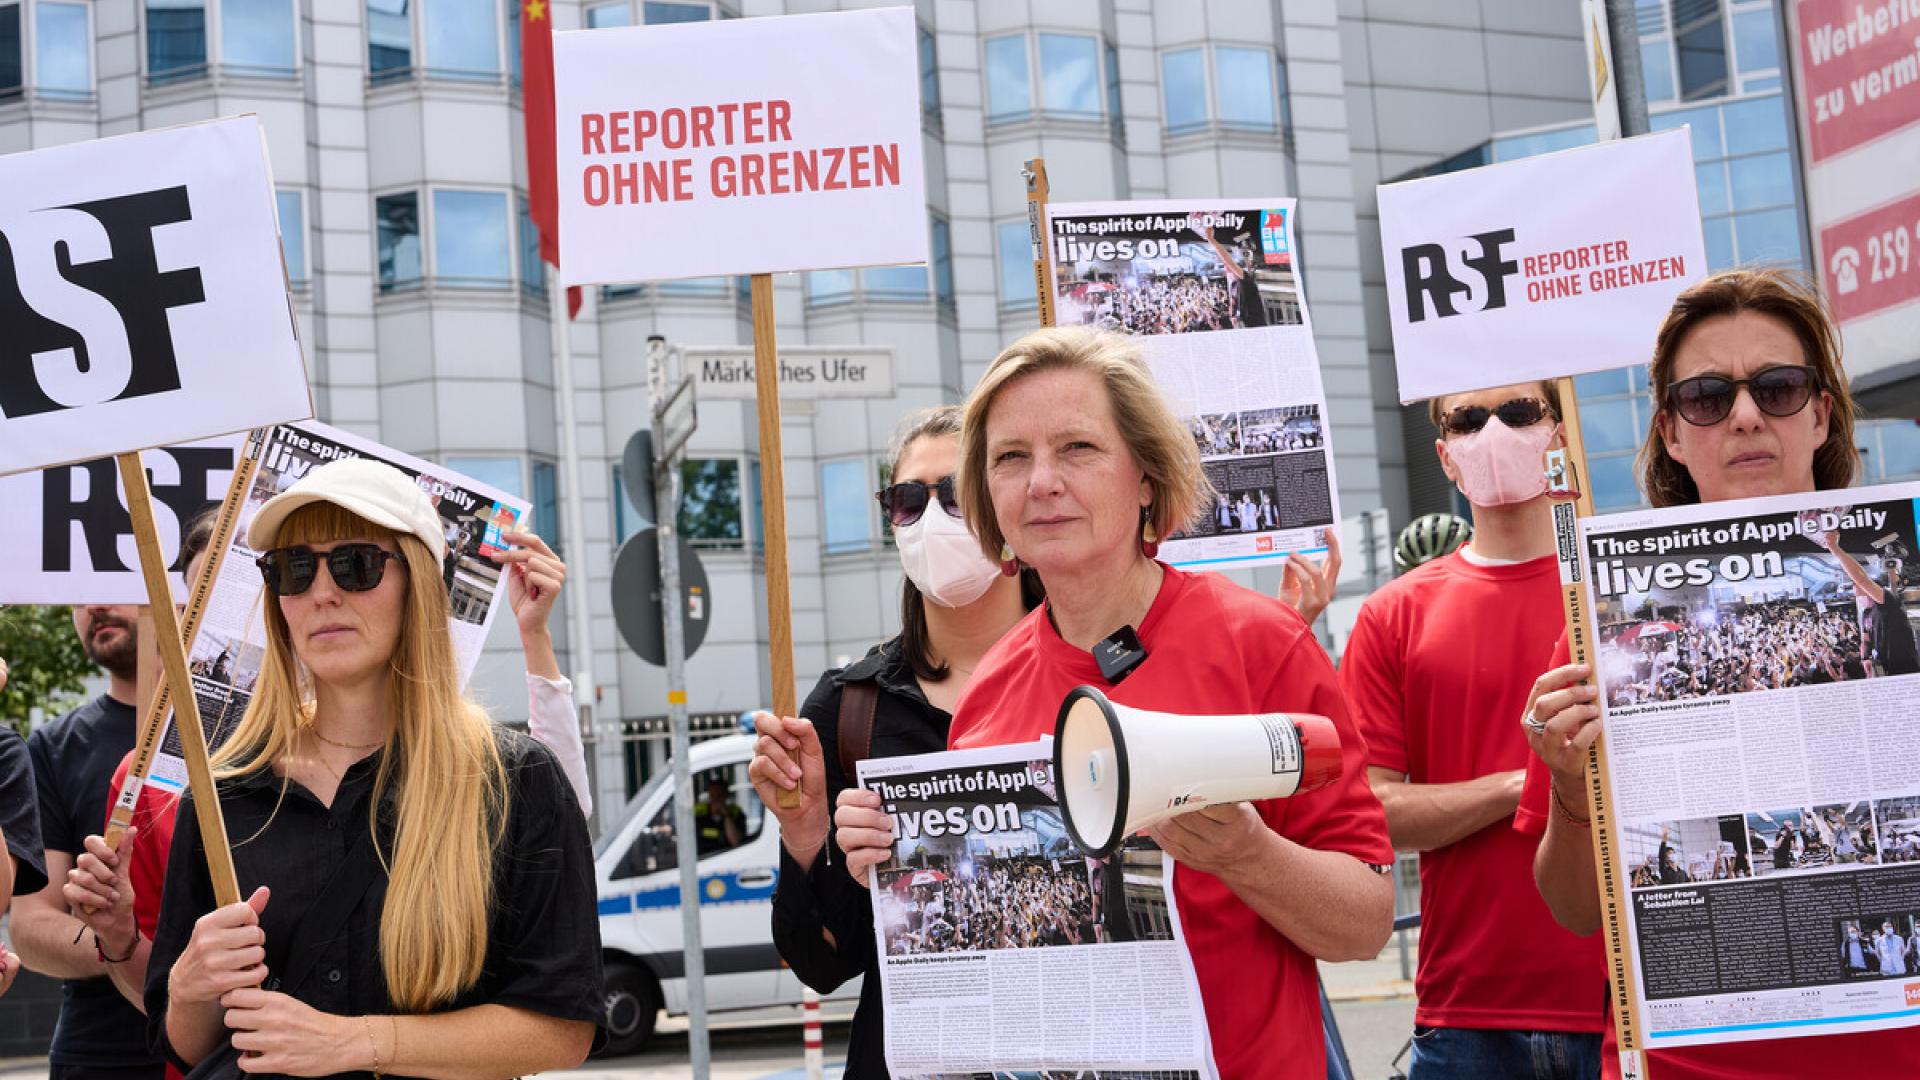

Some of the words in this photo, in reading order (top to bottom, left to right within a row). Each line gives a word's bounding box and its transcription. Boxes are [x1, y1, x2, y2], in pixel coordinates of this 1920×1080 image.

[1808, 0, 1920, 66] Werbefl
[1815, 87, 1844, 124] zu
[581, 100, 792, 155] REPORTER
[583, 159, 693, 206] OHNE
[711, 143, 900, 198] GRENZEN
[1055, 220, 1089, 234] The
[1088, 218, 1134, 236] spirit
[1135, 216, 1152, 231] of
[1153, 213, 1200, 234] Apple
[1202, 212, 1245, 230] Daily
[1057, 236, 1134, 262] lives
[1138, 238, 1180, 258] on
[1524, 240, 1629, 278] REPORTER
[1867, 225, 1909, 284] 259
[1401, 228, 1518, 323] RSF
[1526, 274, 1582, 302] OHNE
[1589, 256, 1686, 292] GRENZEN
[703, 358, 815, 383] Märkhes
[822, 358, 867, 382] Ufer
[278, 426, 310, 449] The
[431, 482, 476, 511] Daily
[1592, 538, 1641, 556] The
[1643, 527, 1711, 555] spirit
[1713, 523, 1739, 543] of
[1743, 515, 1817, 543] Apple
[1820, 508, 1887, 531] Daily
[1596, 557, 1713, 597] lives
[1719, 551, 1783, 581] on
[869, 781, 907, 799] The
[908, 775, 963, 801] spirit
[965, 771, 984, 792] of
[986, 766, 1048, 793] Apple
[884, 804, 969, 840] ives
[972, 802, 1022, 834] on
